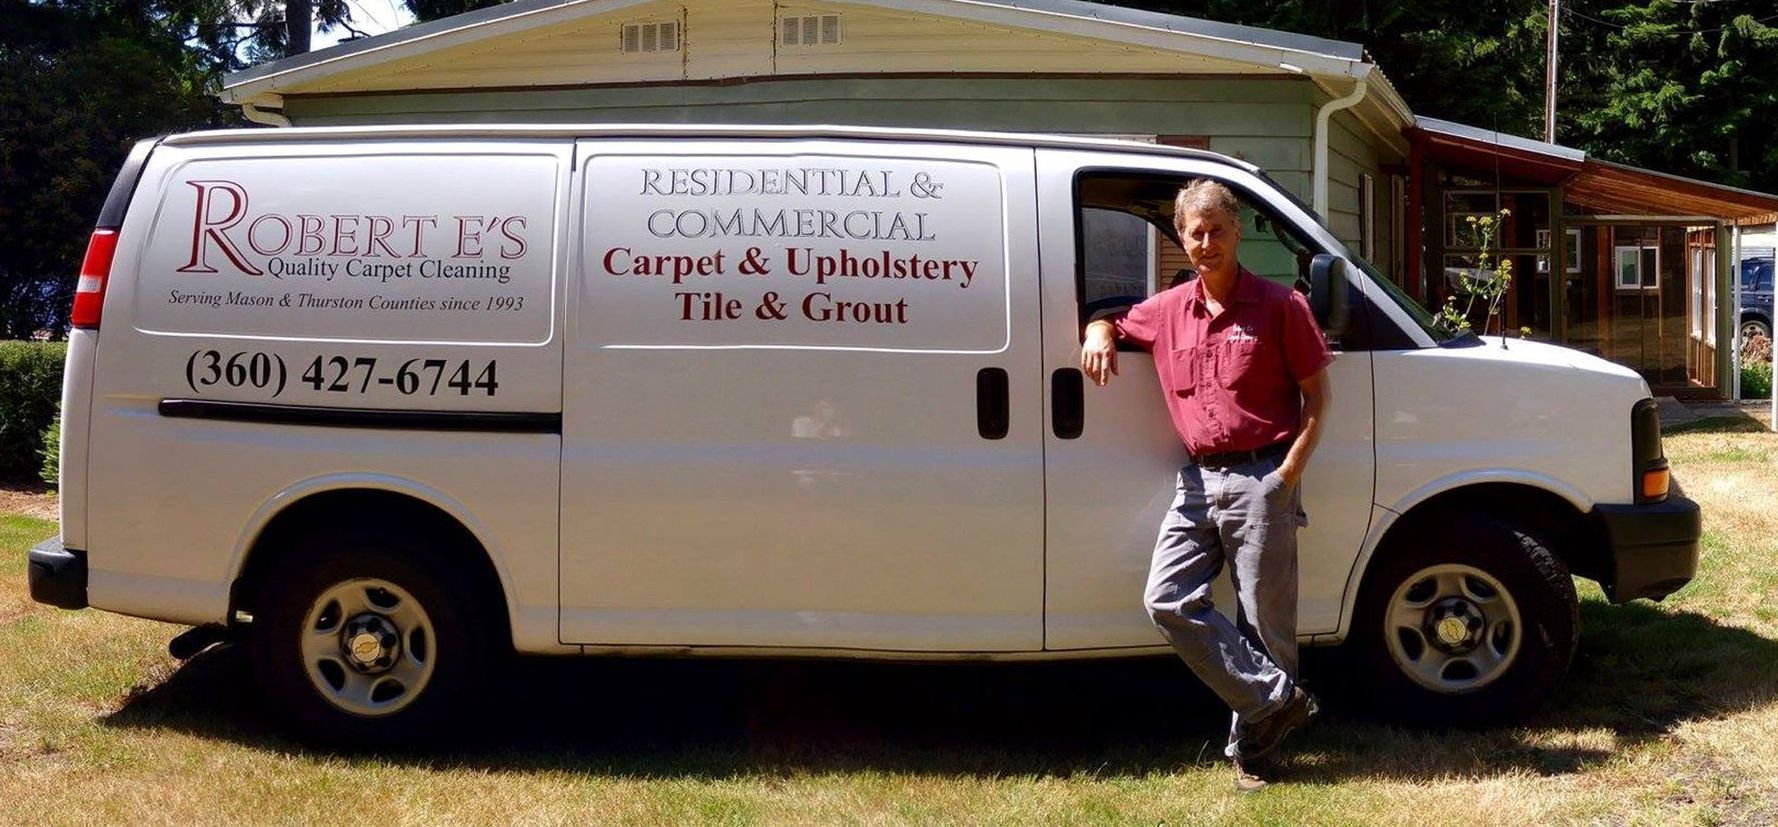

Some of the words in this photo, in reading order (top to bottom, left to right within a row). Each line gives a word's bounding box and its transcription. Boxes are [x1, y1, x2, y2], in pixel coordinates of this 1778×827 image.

[640, 168, 901, 198] RESIDENTIAL
[909, 171, 944, 199] &
[176, 180, 437, 276] ROBERT
[647, 208, 936, 241] COMMERCIAL
[267, 257, 339, 280] Quality
[346, 259, 413, 282] Carpet
[420, 259, 511, 284] Cleaning
[603, 247, 726, 284] Carpet
[738, 246, 771, 276] &
[785, 248, 979, 289] Upholstery
[168, 290, 222, 309] Serving
[225, 292, 274, 307] Mason
[278, 293, 291, 308] &
[297, 293, 364, 310] Thurston
[368, 294, 436, 311] Counties
[439, 296, 480, 311] since
[486, 296, 524, 312] 1993
[675, 292, 742, 321] Tile
[755, 291, 788, 320] &
[801, 292, 909, 324] Grout
[185, 349, 287, 398] (360)
[302, 355, 499, 397] 427-6744
